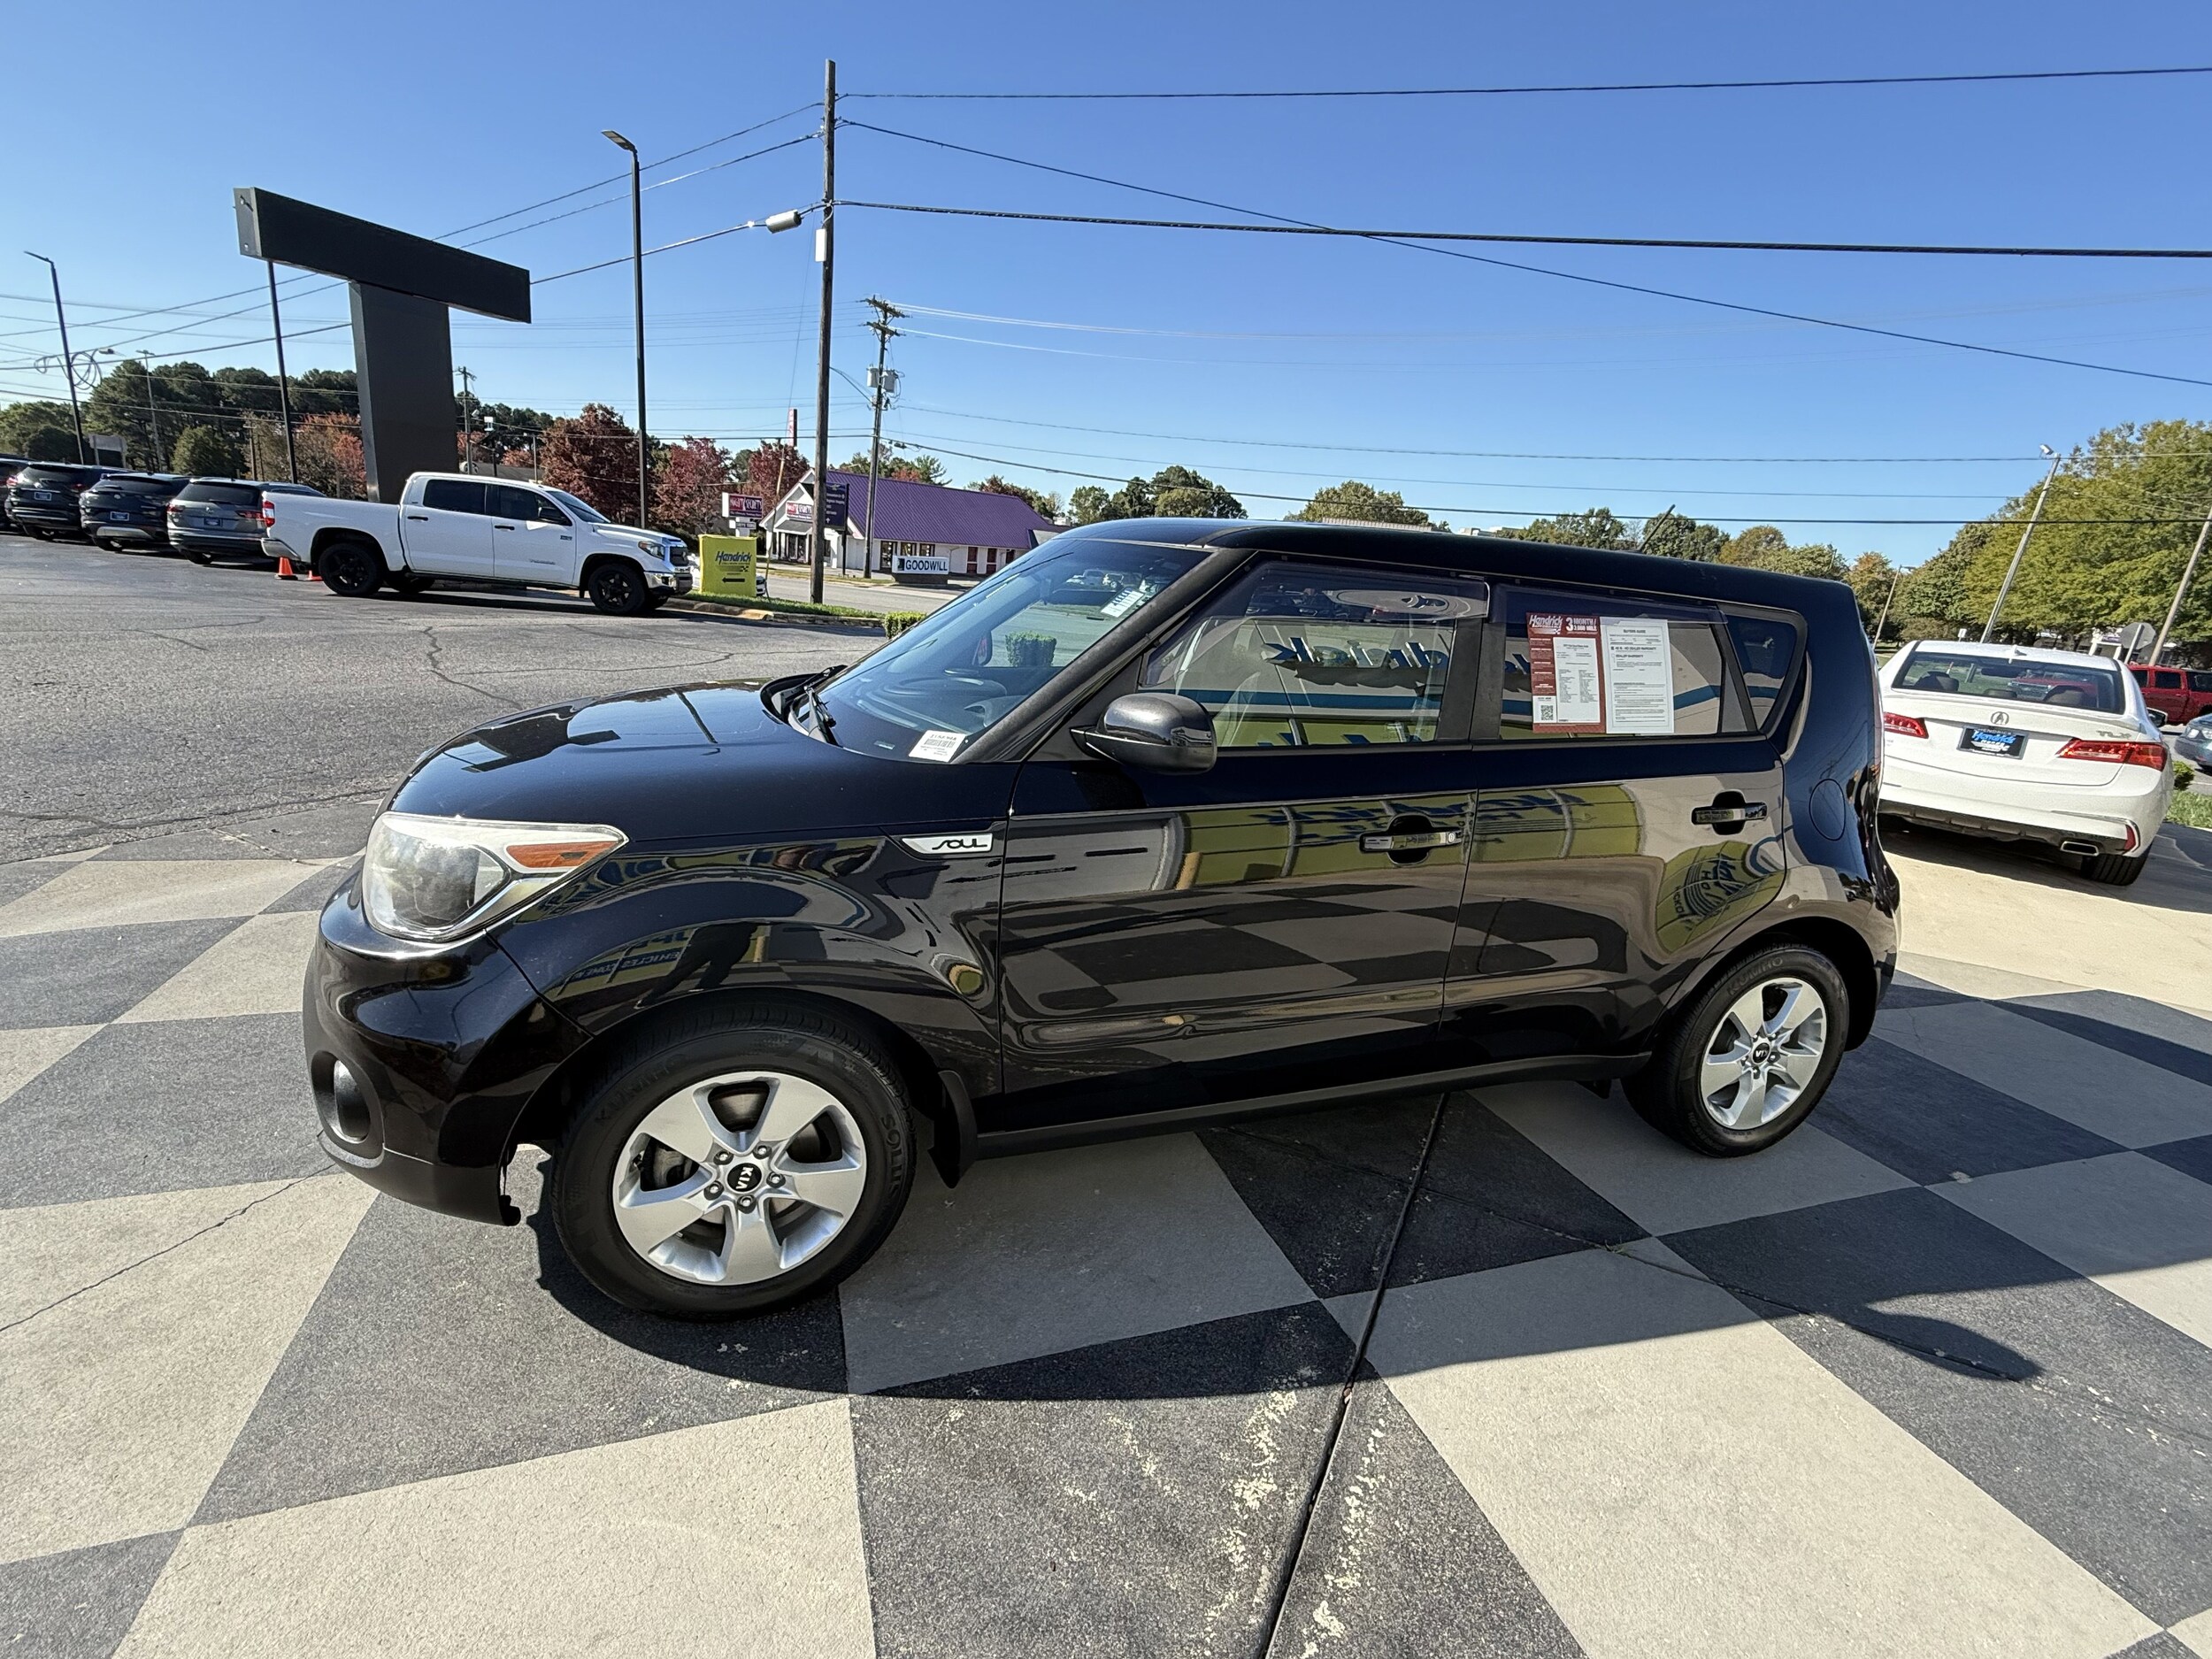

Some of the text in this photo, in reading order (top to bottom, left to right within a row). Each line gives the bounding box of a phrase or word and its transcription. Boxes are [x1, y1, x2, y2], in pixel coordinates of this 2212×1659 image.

[715, 550, 752, 565] Hendrick
[905, 559, 948, 572] GOODWILL
[1529, 614, 1563, 626] Hendrick
[1565, 617, 1574, 632] 3
[1971, 730, 2016, 744] Hendrick
[932, 838, 987, 850] SOUL
[1726, 956, 1784, 996] KUMHO
[735, 1167, 754, 1190] KIA
